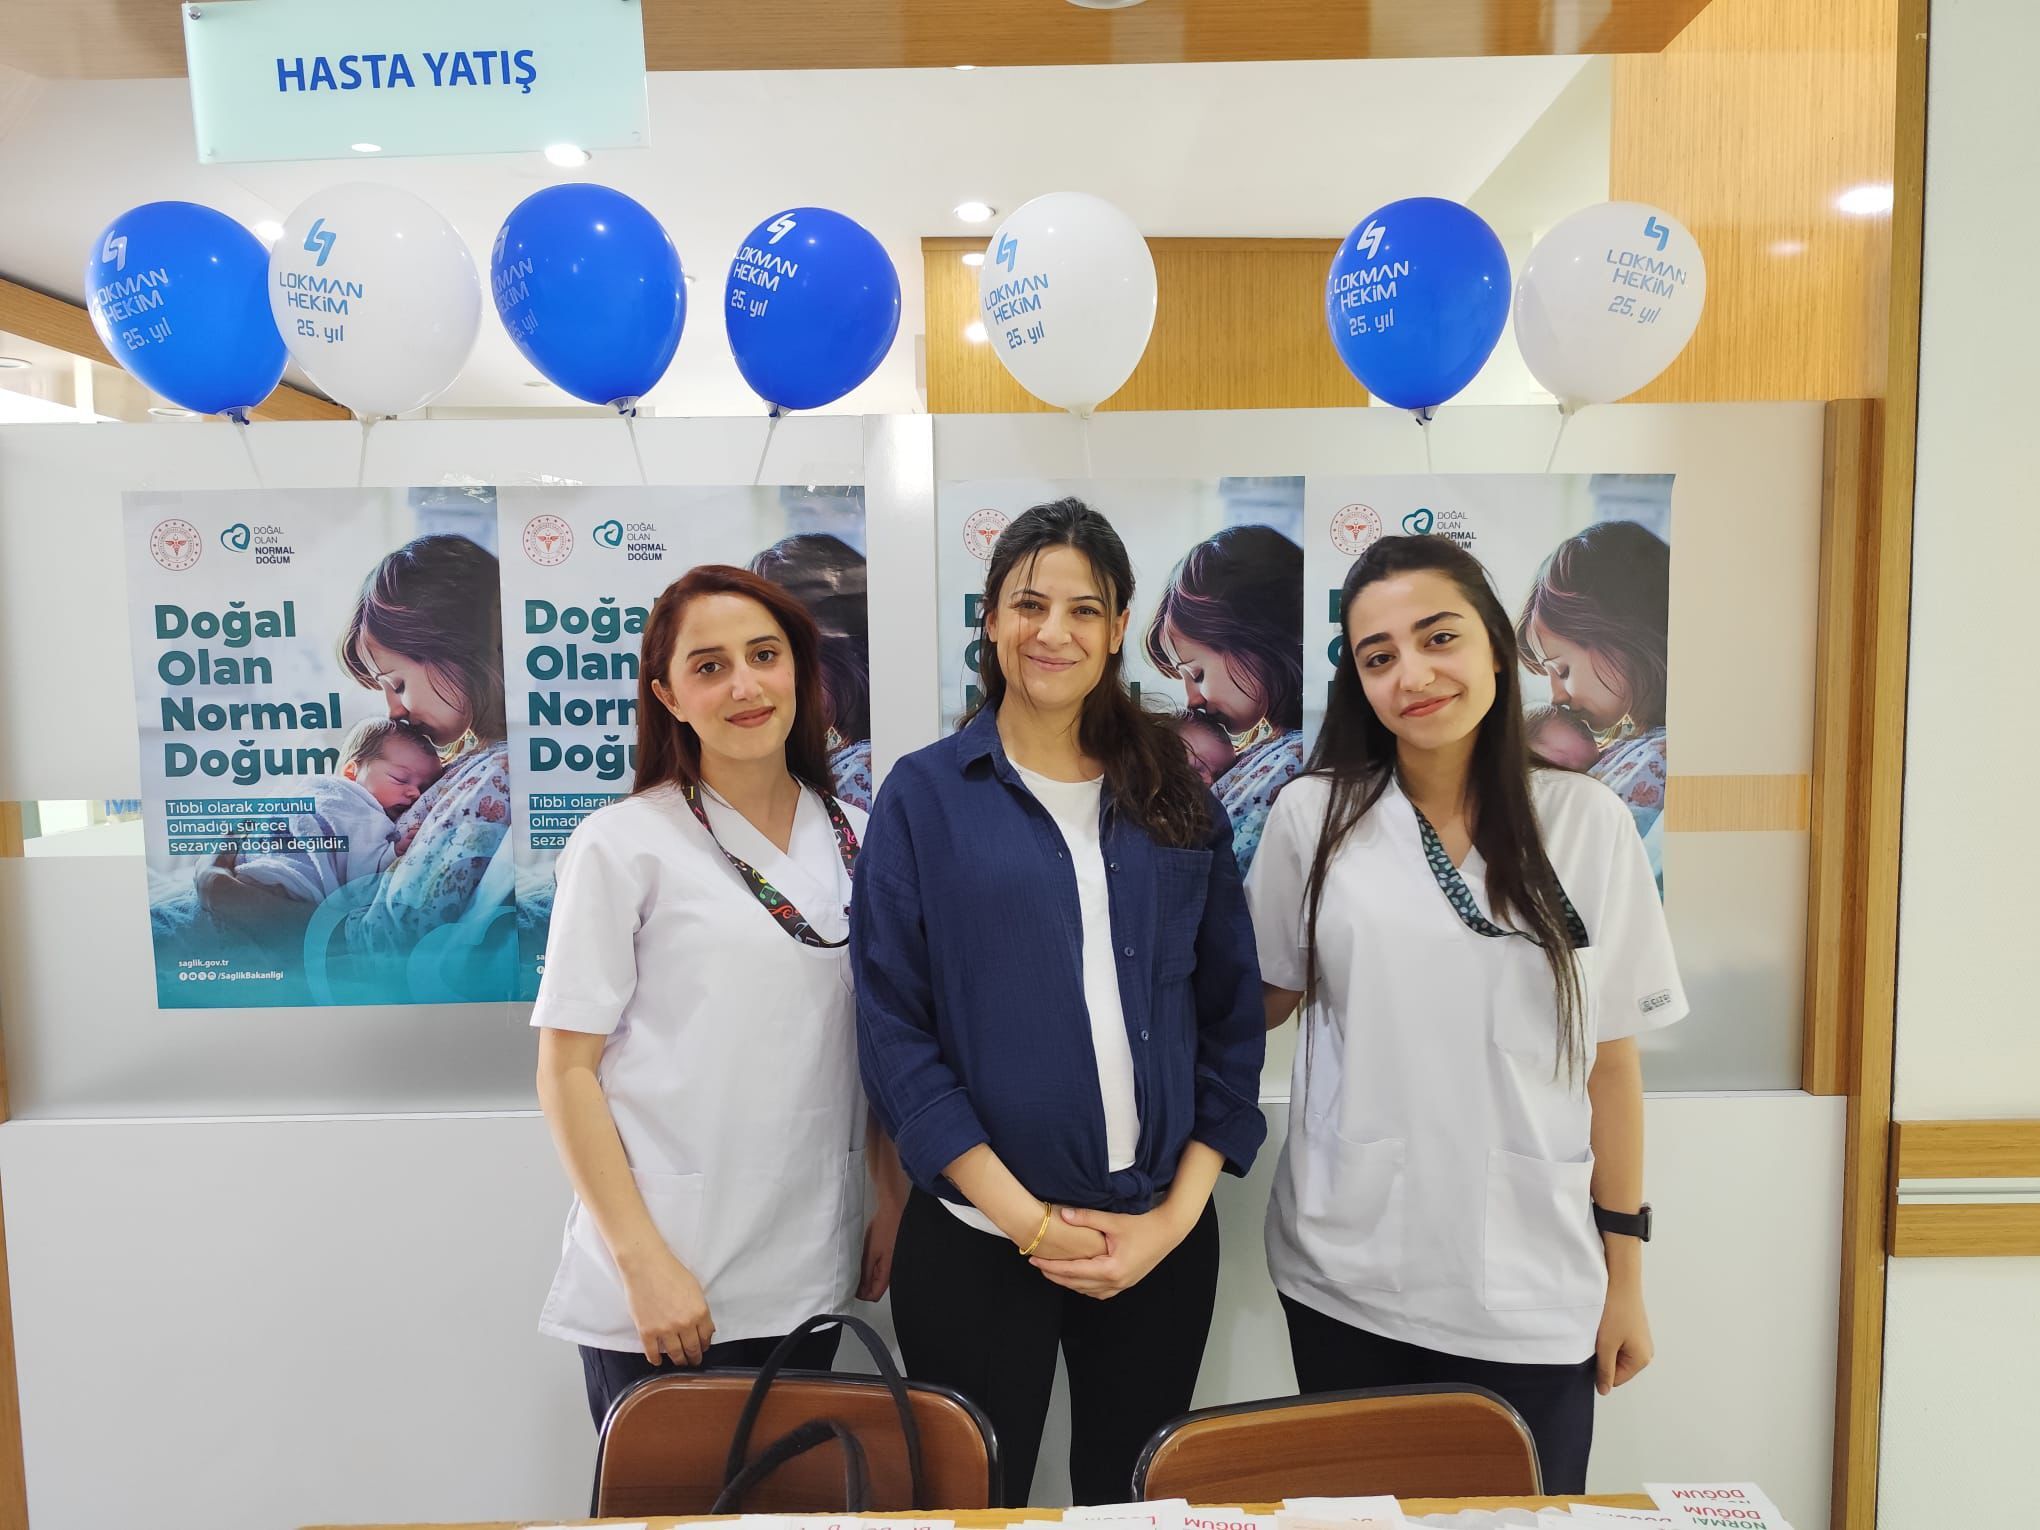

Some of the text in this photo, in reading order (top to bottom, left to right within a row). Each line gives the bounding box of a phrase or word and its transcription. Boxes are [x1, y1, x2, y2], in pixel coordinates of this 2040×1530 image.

[276, 50, 537, 94] HASTA YATIŞ
[735, 246, 799, 278] LOKMAN
[1606, 248, 1687, 286] LOKMAN
[95, 268, 169, 306] OKMAN
[279, 272, 363, 299] LOKMAN
[1334, 260, 1409, 295] LOKMAN
[731, 288, 769, 318] 25. yıl
[984, 273, 1049, 311] LOKMAN
[1349, 308, 1394, 337] 25. yıl
[1607, 295, 1662, 324] 25. yıl
[122, 317, 172, 350] 25. yıl
[296, 318, 344, 343] 25. yıl
[1006, 320, 1045, 350] 25. yıl
[626, 522, 657, 532] DOĞAL
[1436, 521, 1461, 529] OLAN
[1437, 510, 1468, 520] DOĞAL
[253, 525, 285, 535] DOĞAL
[254, 537, 278, 545] OLAN
[627, 533, 651, 541] OLAN
[255, 546, 295, 555] NORMAL
[255, 554, 291, 565] DOĞUM
[627, 543, 667, 552] NORMAL
[627, 552, 663, 561] DOĞUM
[155, 600, 296, 648] Doğal
[525, 597, 660, 644] Doğa
[158, 648, 273, 686] Olan
[526, 644, 640, 681] Olan
[160, 692, 342, 732] Normal
[528, 691, 639, 726] Nor
[164, 739, 341, 786] Doğum
[530, 735, 639, 781] Doğ
[168, 800, 313, 814] Tıbbi olarak zorunlu
[530, 796, 566, 808] Tıbbi
[169, 819, 287, 834] olmadığı sürece
[170, 838, 347, 854] sezaryen doğal değildir.
[178, 959, 230, 969] saglik.gov.tr
[1671, 1489, 1745, 1500] DOĞUM
[1683, 1505, 1761, 1519] DOĞUM
